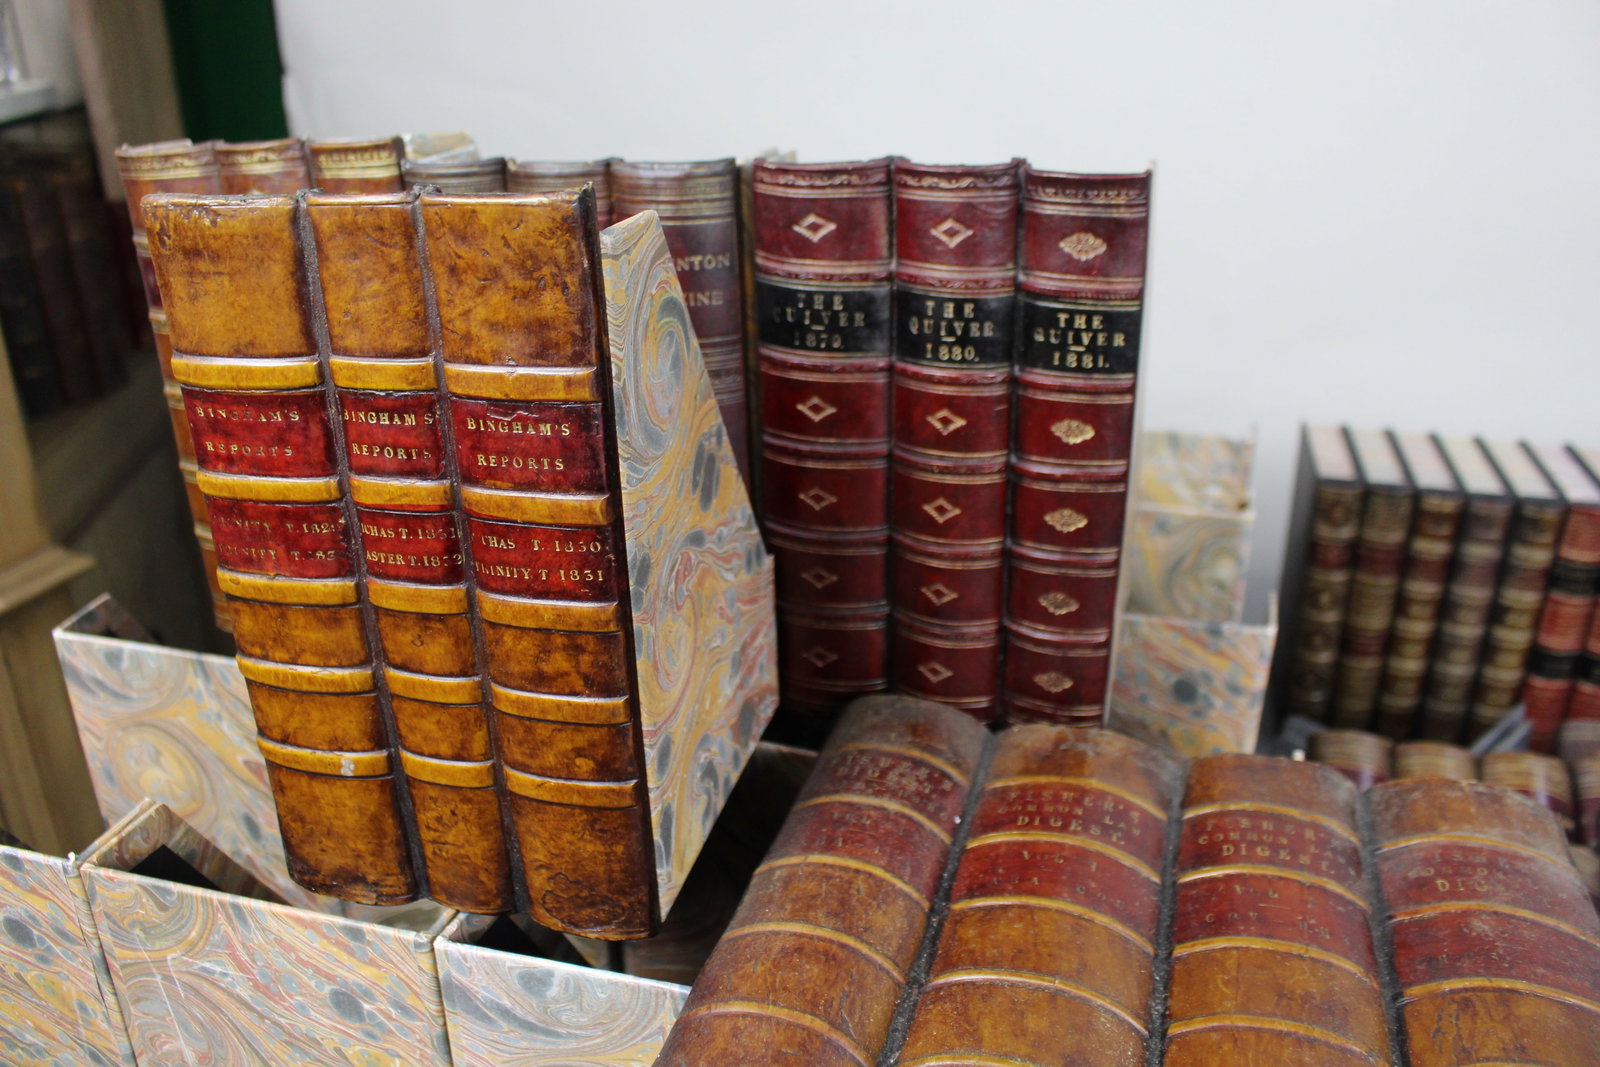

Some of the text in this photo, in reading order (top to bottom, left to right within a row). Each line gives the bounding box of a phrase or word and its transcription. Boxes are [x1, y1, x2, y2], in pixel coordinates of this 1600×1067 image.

[925, 300, 975, 319] THE
[909, 315, 994, 338] QUIVER
[1056, 311, 1104, 330] THE
[1034, 326, 1126, 347] QUIVER
[466, 417, 571, 436] BINGHAM'S
[205, 441, 293, 457] REPORTS
[352, 442, 432, 460] REPORTS
[477, 454, 564, 470] REPORTS
